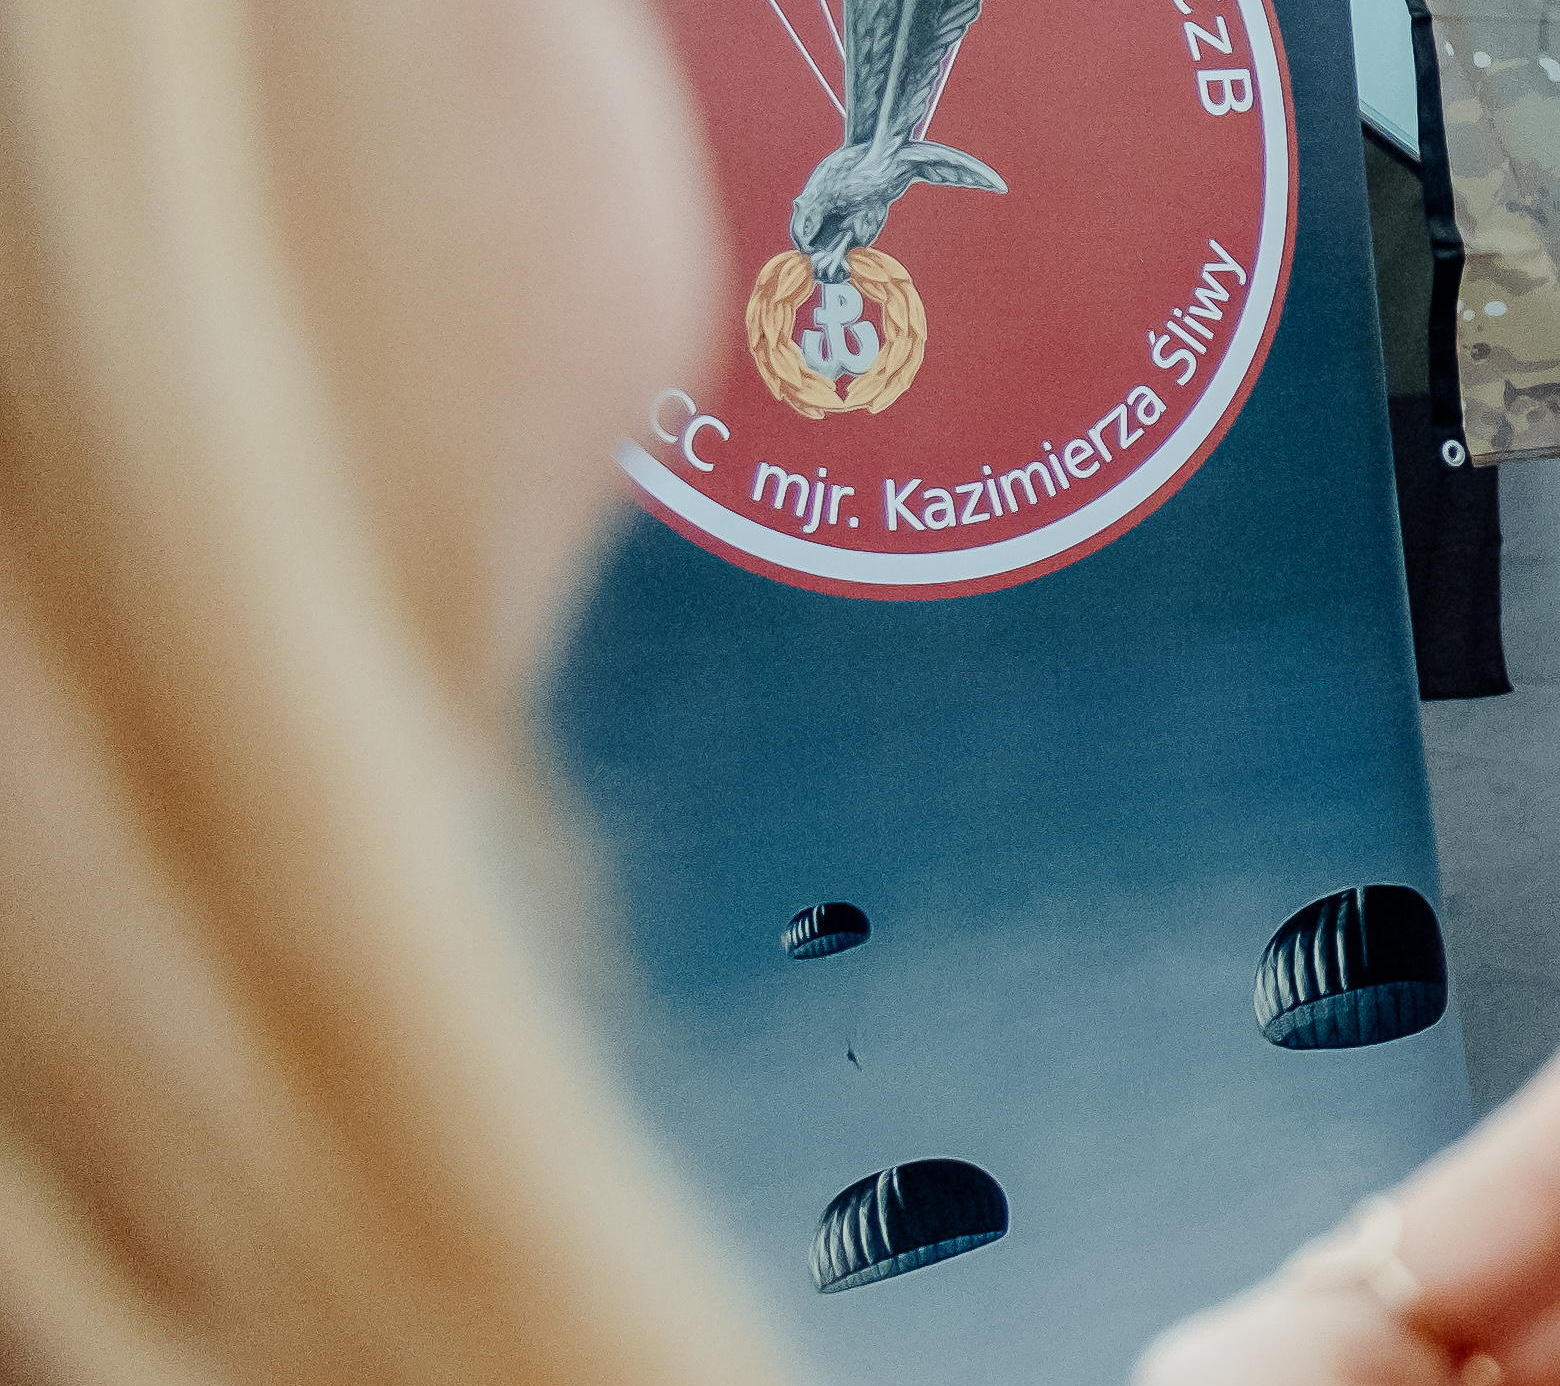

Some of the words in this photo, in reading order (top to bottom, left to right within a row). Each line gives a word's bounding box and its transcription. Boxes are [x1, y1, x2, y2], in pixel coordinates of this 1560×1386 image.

[750, 460, 861, 535] mjr.
[883, 384, 1168, 534] Kazimierza
[1149, 237, 1252, 387] Śliwy
